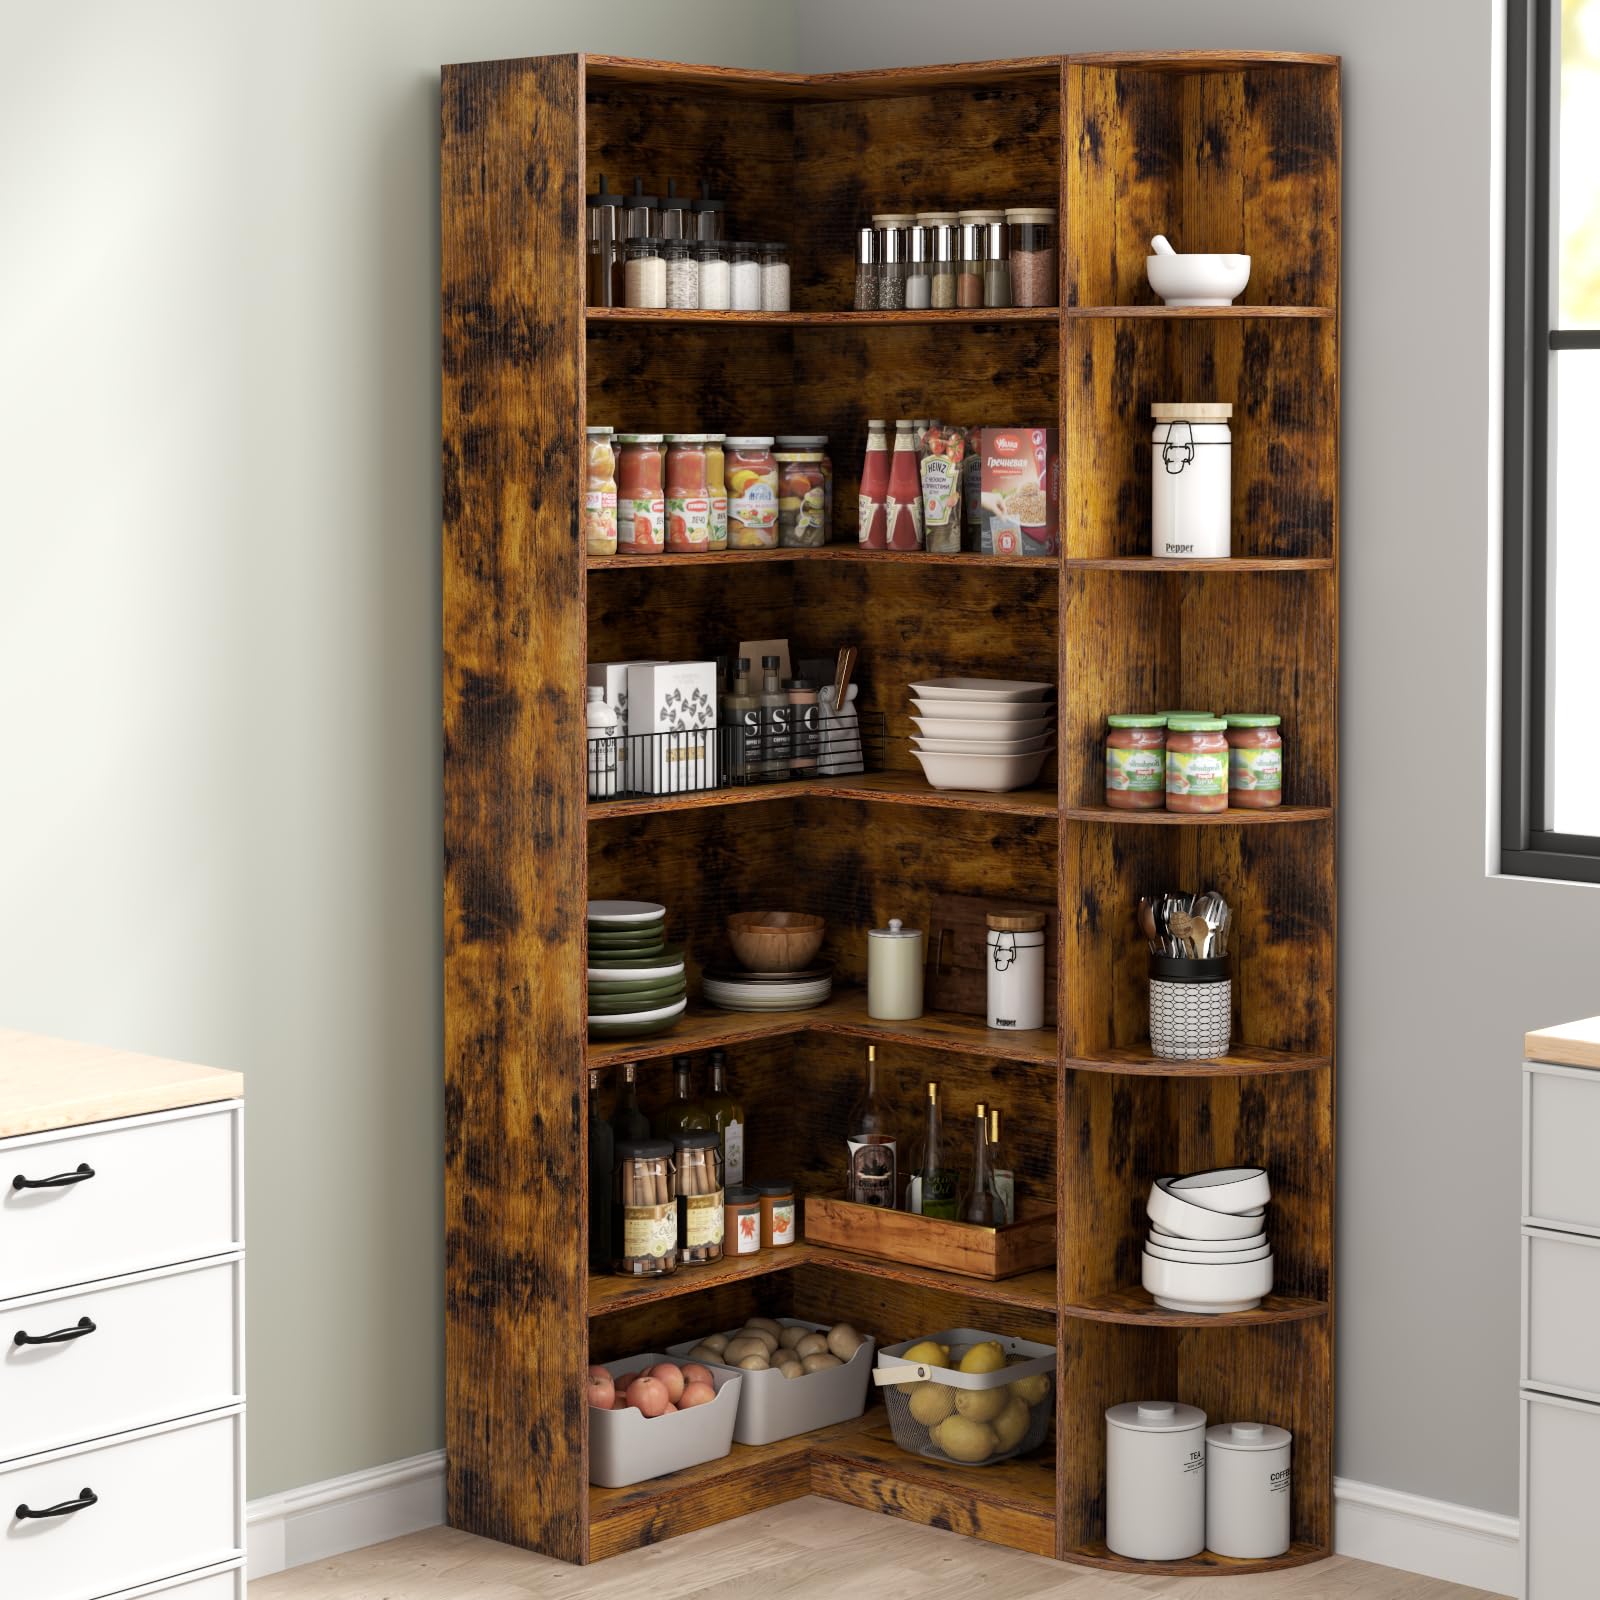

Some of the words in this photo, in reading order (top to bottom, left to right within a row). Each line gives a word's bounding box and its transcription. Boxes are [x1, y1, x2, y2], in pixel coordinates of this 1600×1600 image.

[928, 462, 947, 473] HEINZ
[1165, 543, 1194, 554] Pepper
[1190, 1451, 1201, 1460] TEA
